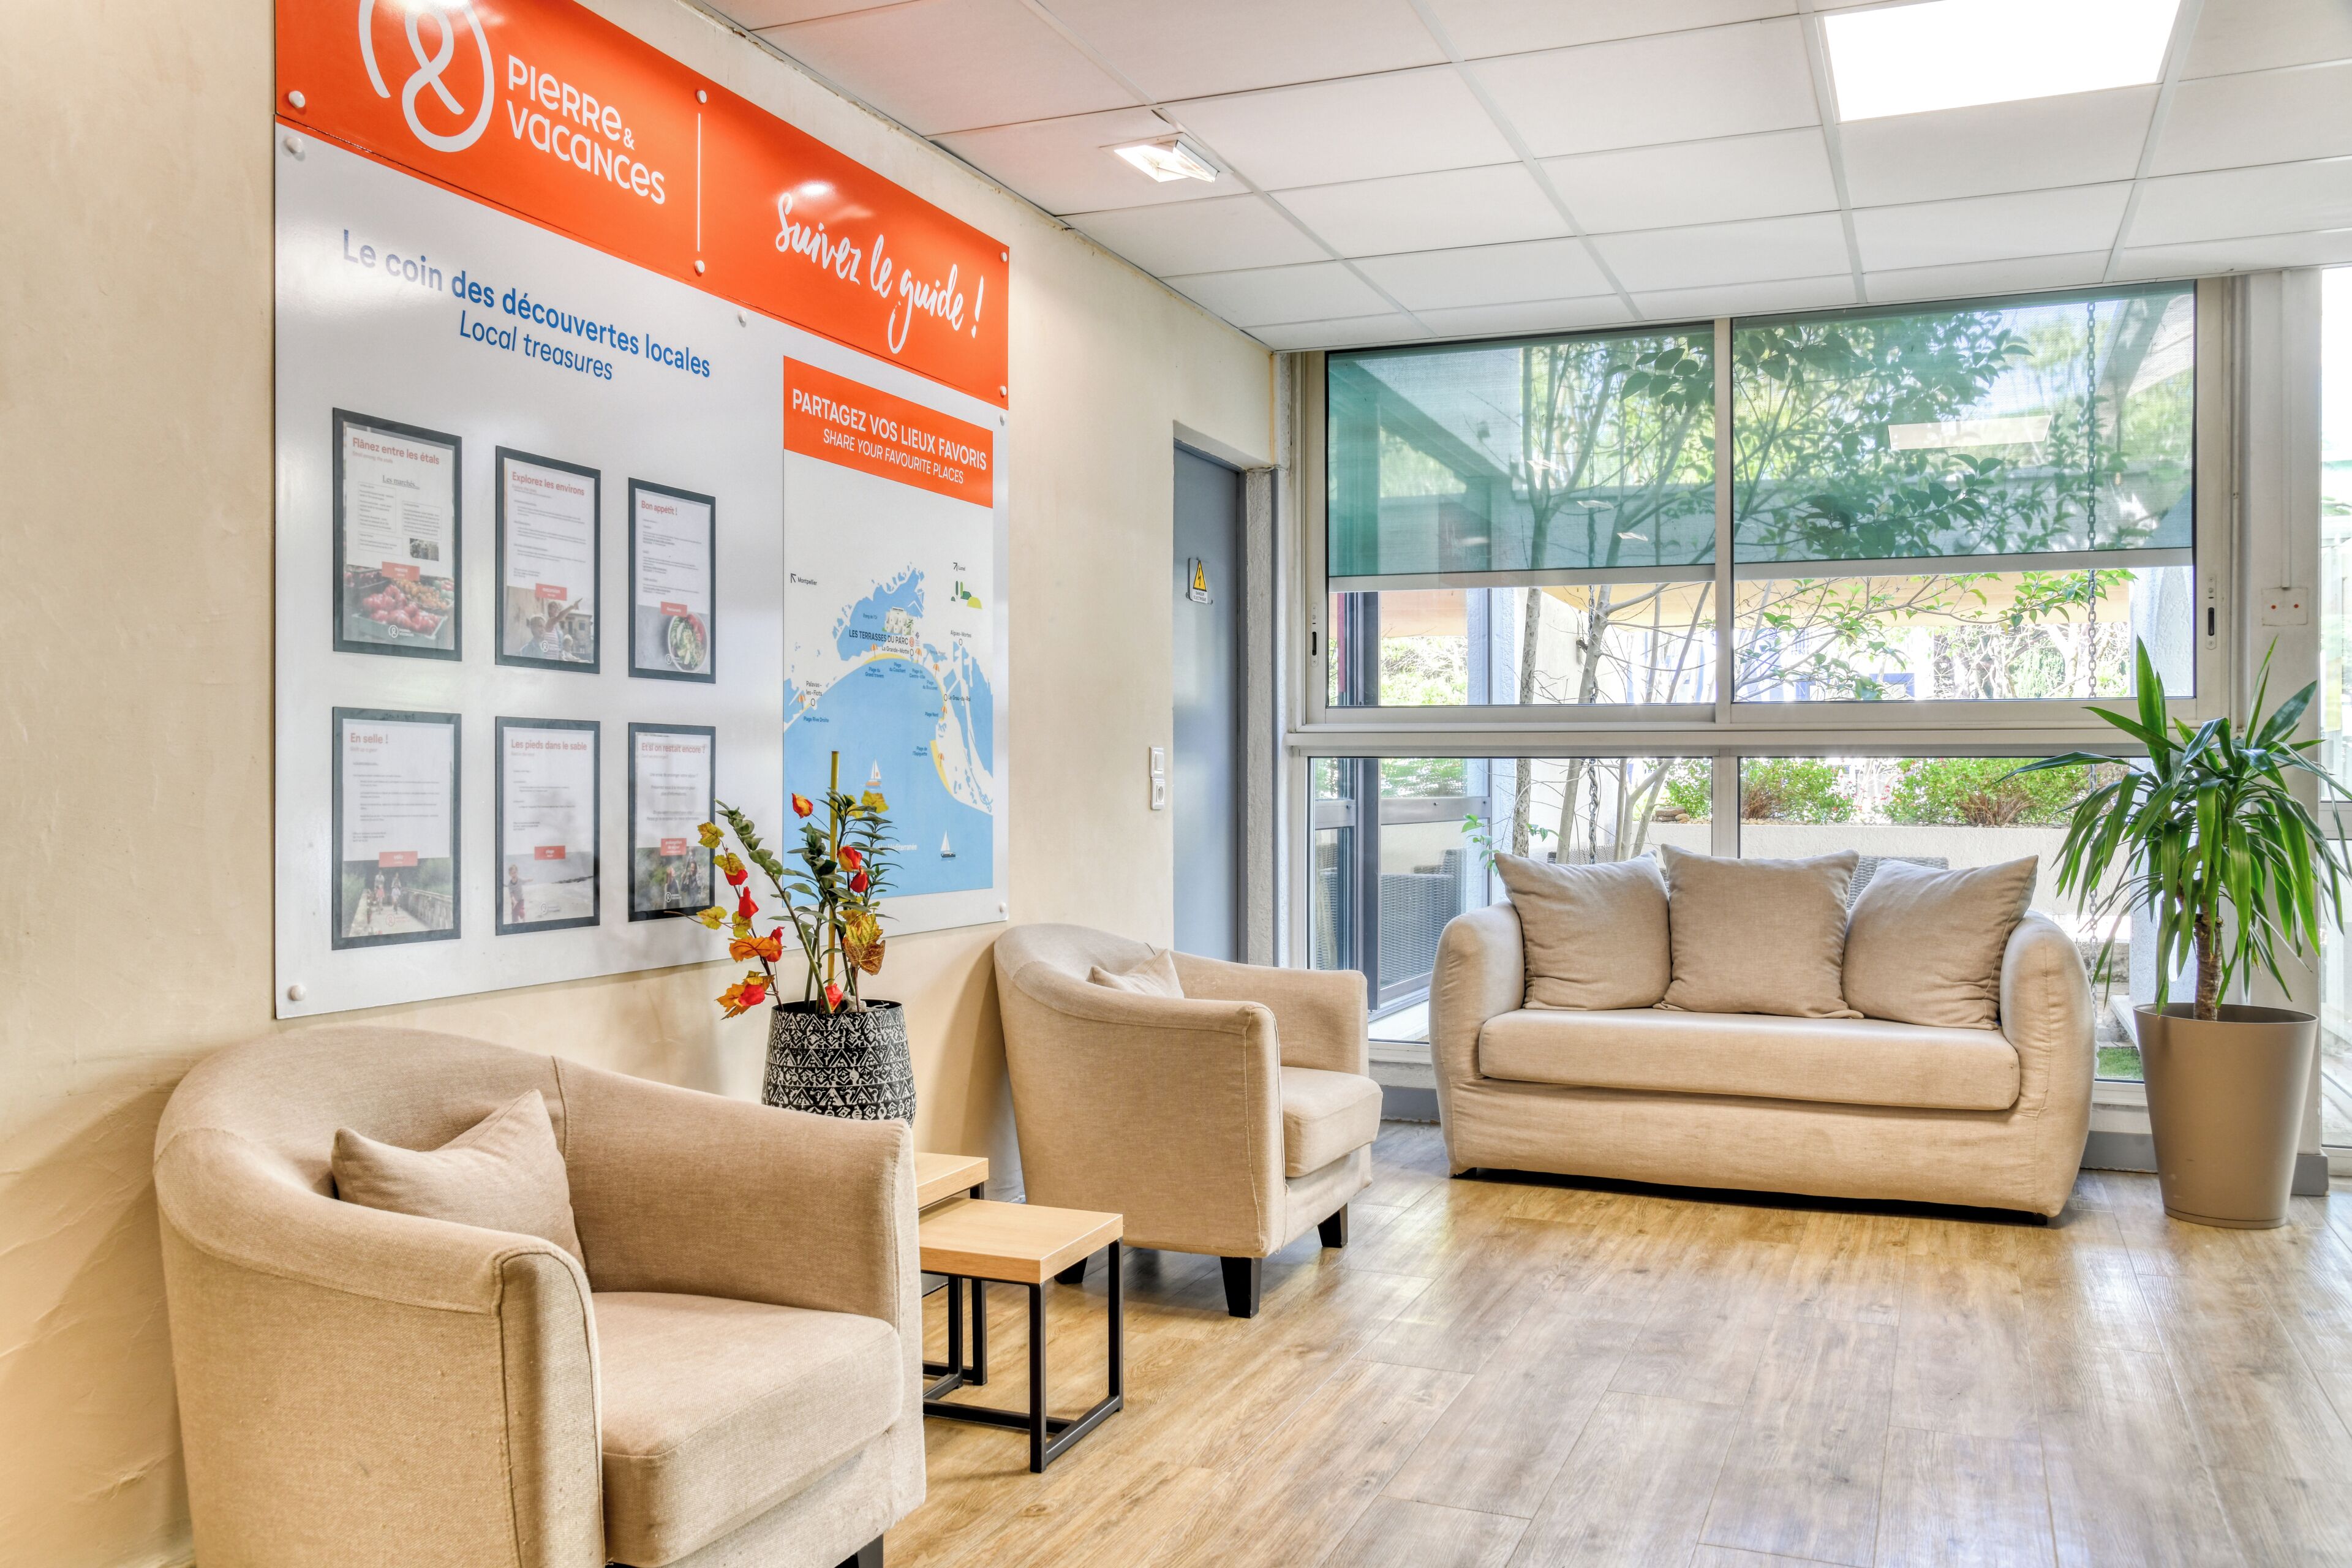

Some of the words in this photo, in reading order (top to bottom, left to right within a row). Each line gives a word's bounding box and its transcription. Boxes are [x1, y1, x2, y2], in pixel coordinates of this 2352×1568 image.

[775, 192, 861, 285] Suivez
[870, 234, 892, 298] le
[888, 263, 963, 354] guide
[343, 228, 376, 268] Le
[385, 255, 442, 291] coin
[451, 270, 494, 308] des
[502, 287, 639, 356] découvertes
[646, 333, 710, 378] locales
[459, 310, 517, 352] Local
[523, 333, 612, 380] treasures
[793, 388, 866, 432] PARTAGEZ
[870, 414, 898, 442] VOS
[901, 424, 935, 453] LIEUX
[938, 438, 987, 470] FAVORIS
[352, 437, 380, 452] Flânez
[382, 446, 405, 458] entre
[406, 449, 418, 460] les
[420, 452, 440, 465] étals
[823, 428, 855, 452] SHARE
[857, 439, 883, 461] YOUR
[885, 448, 931, 475] FAVOURITE
[933, 463, 963, 484] PLACES
[512, 472, 543, 487] Explorez
[544, 479, 554, 489] les
[556, 483, 585, 496] environs
[641, 500, 652, 510] Bon
[849, 629, 858, 638] LES
[859, 631, 887, 642] TERRASSES
[895, 636, 908, 645] PARC
[350, 733, 361, 743] En
[363, 733, 383, 744] selle
[511, 739, 524, 749] Les
[525, 740, 543, 750] pieds
[545, 741, 561, 750] dans
[562, 741, 569, 750] le
[570, 742, 587, 751] sable
[641, 742, 647, 751] Et
